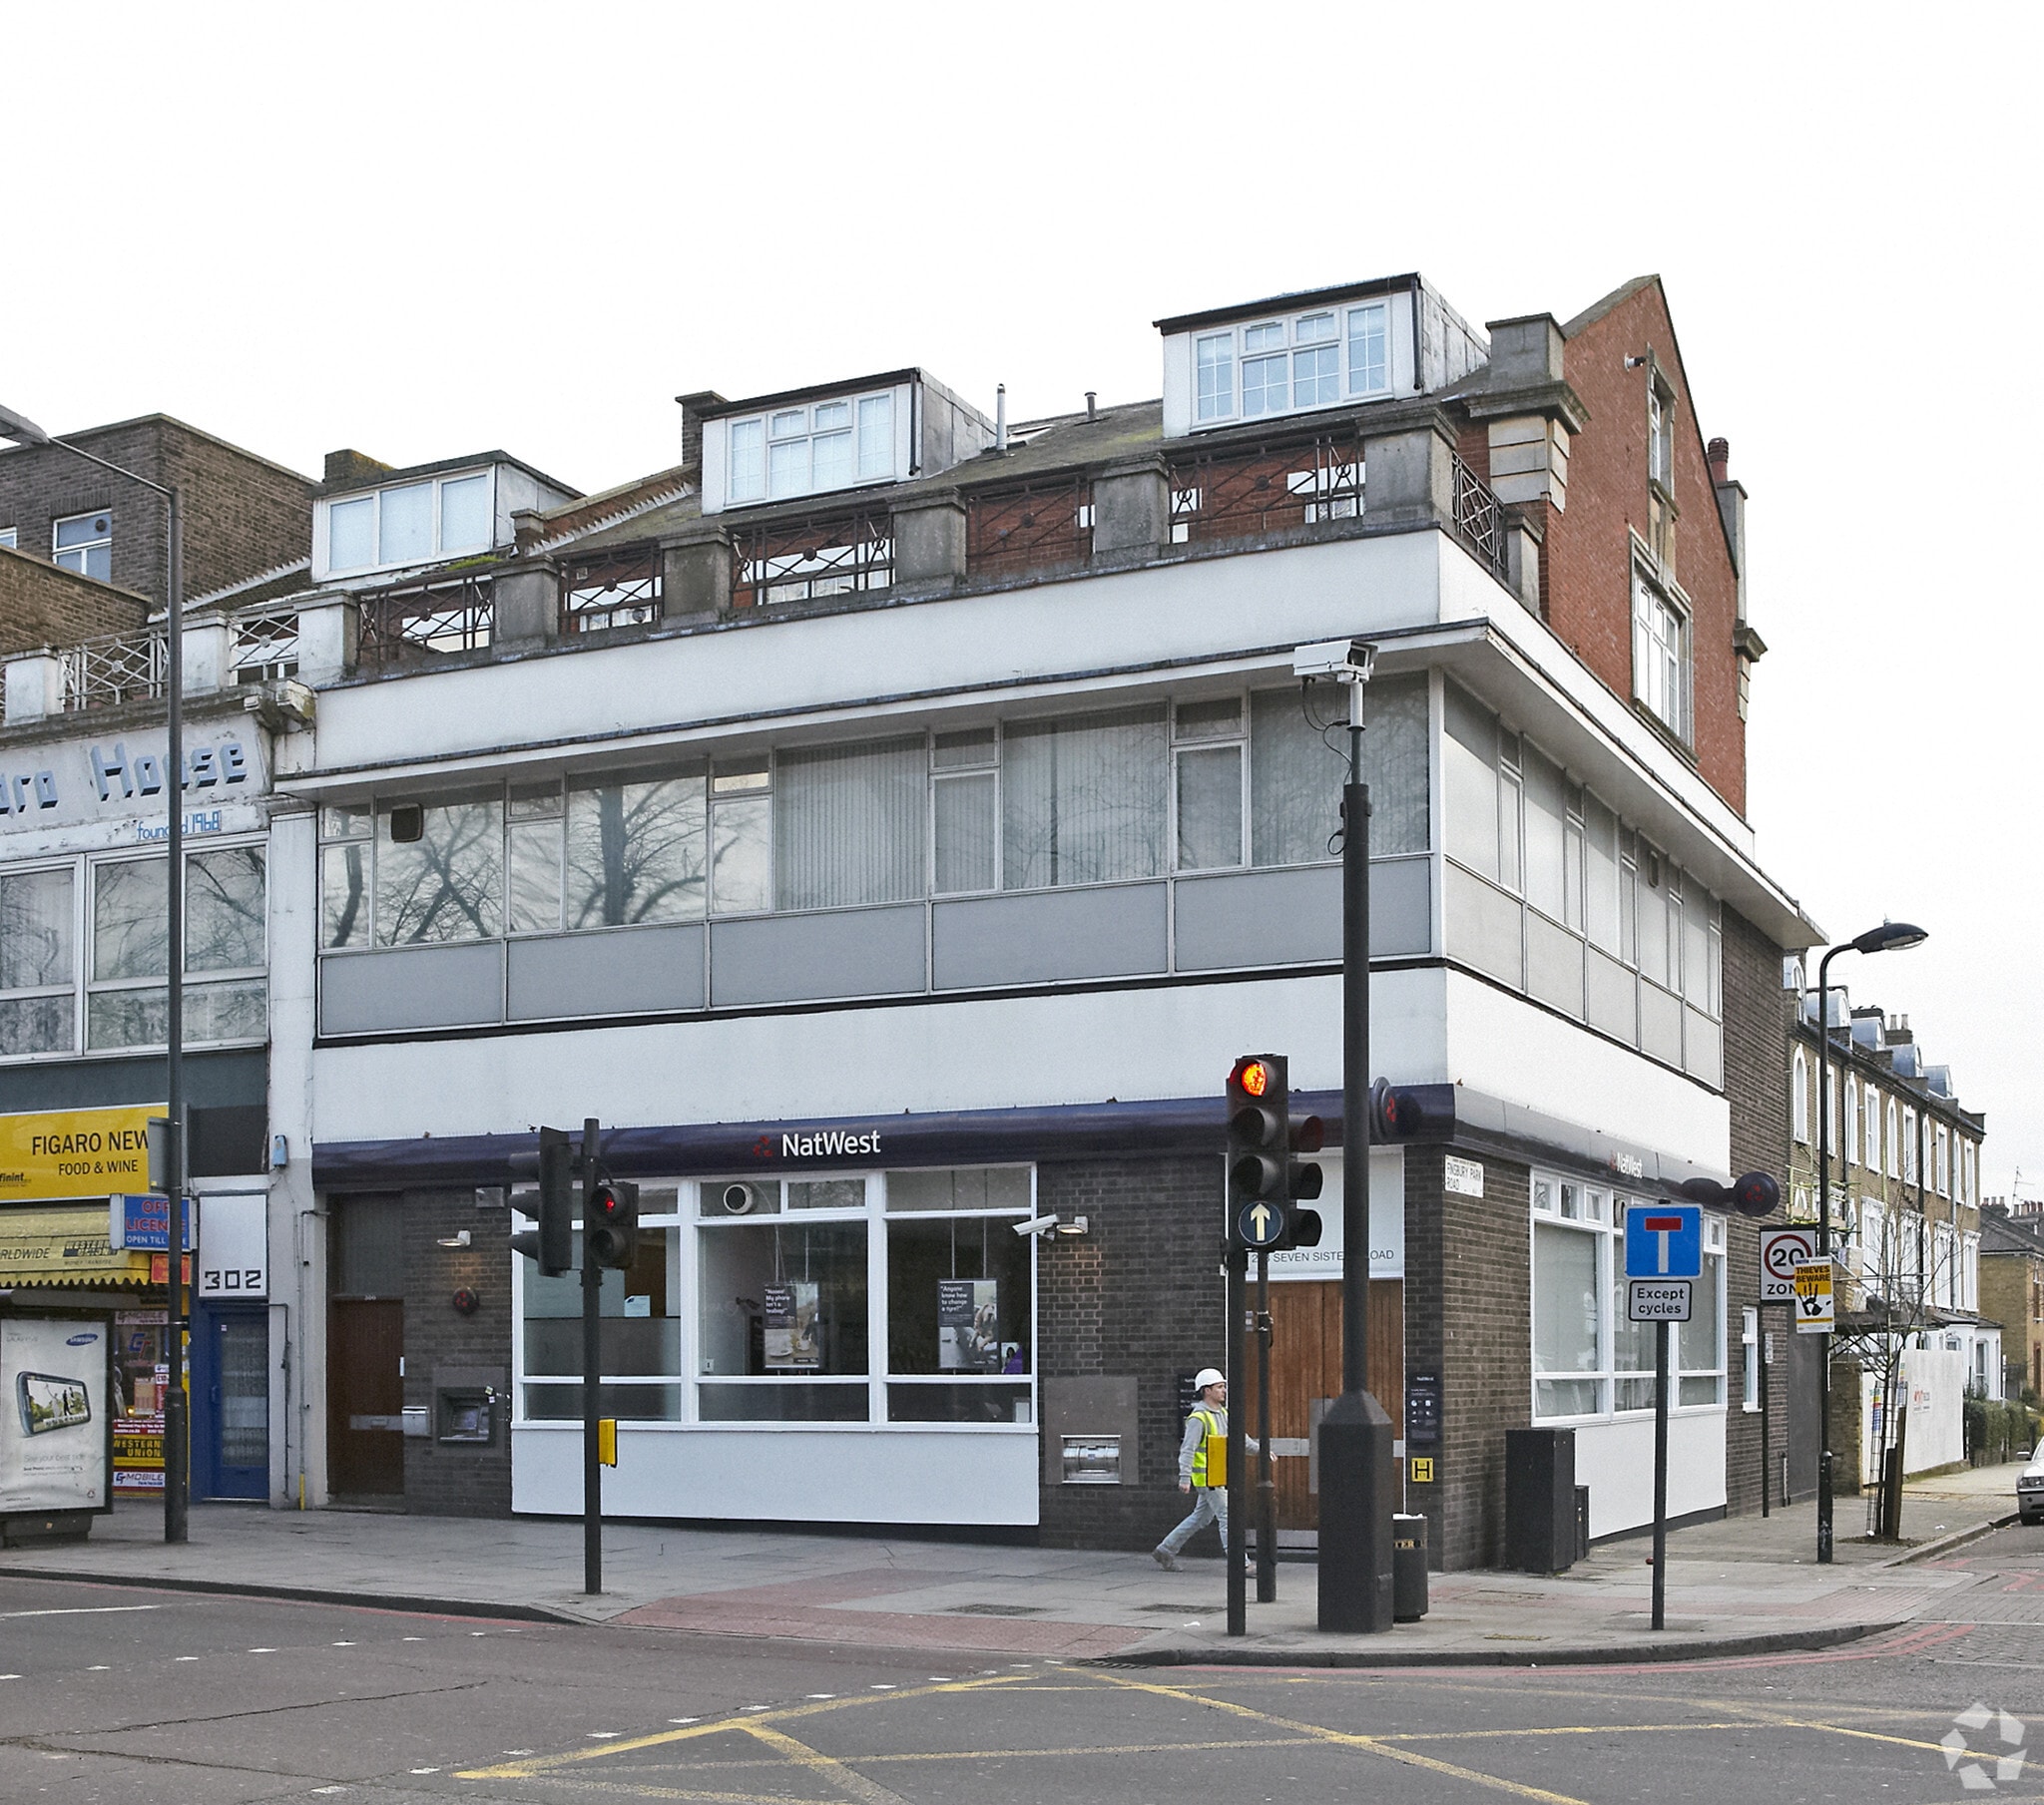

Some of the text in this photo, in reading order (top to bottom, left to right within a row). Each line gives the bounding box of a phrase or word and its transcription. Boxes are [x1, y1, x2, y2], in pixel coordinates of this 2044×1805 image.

[32, 1132, 102, 1155] FIGARO
[782, 1129, 881, 1157] NatWest
[58, 1159, 139, 1175] FOOD & WINE
[1617, 1151, 1643, 1179] NatWest
[126, 1218, 187, 1232] LICENE
[126, 1235, 149, 1244] OPEN
[1273, 1252, 1309, 1263] SEVEN
[1369, 1249, 1394, 1260] OAD
[1772, 1247, 1805, 1267] 20
[1795, 1265, 1830, 1274] THIEVES
[205, 1269, 261, 1290] 302
[1795, 1273, 1830, 1283] BEWARE
[1637, 1287, 1685, 1301] Except
[1767, 1283, 1795, 1295] ZON
[1638, 1303, 1682, 1314] cycles
[114, 1439, 161, 1448] WESTERN
[127, 1448, 161, 1457] UNION
